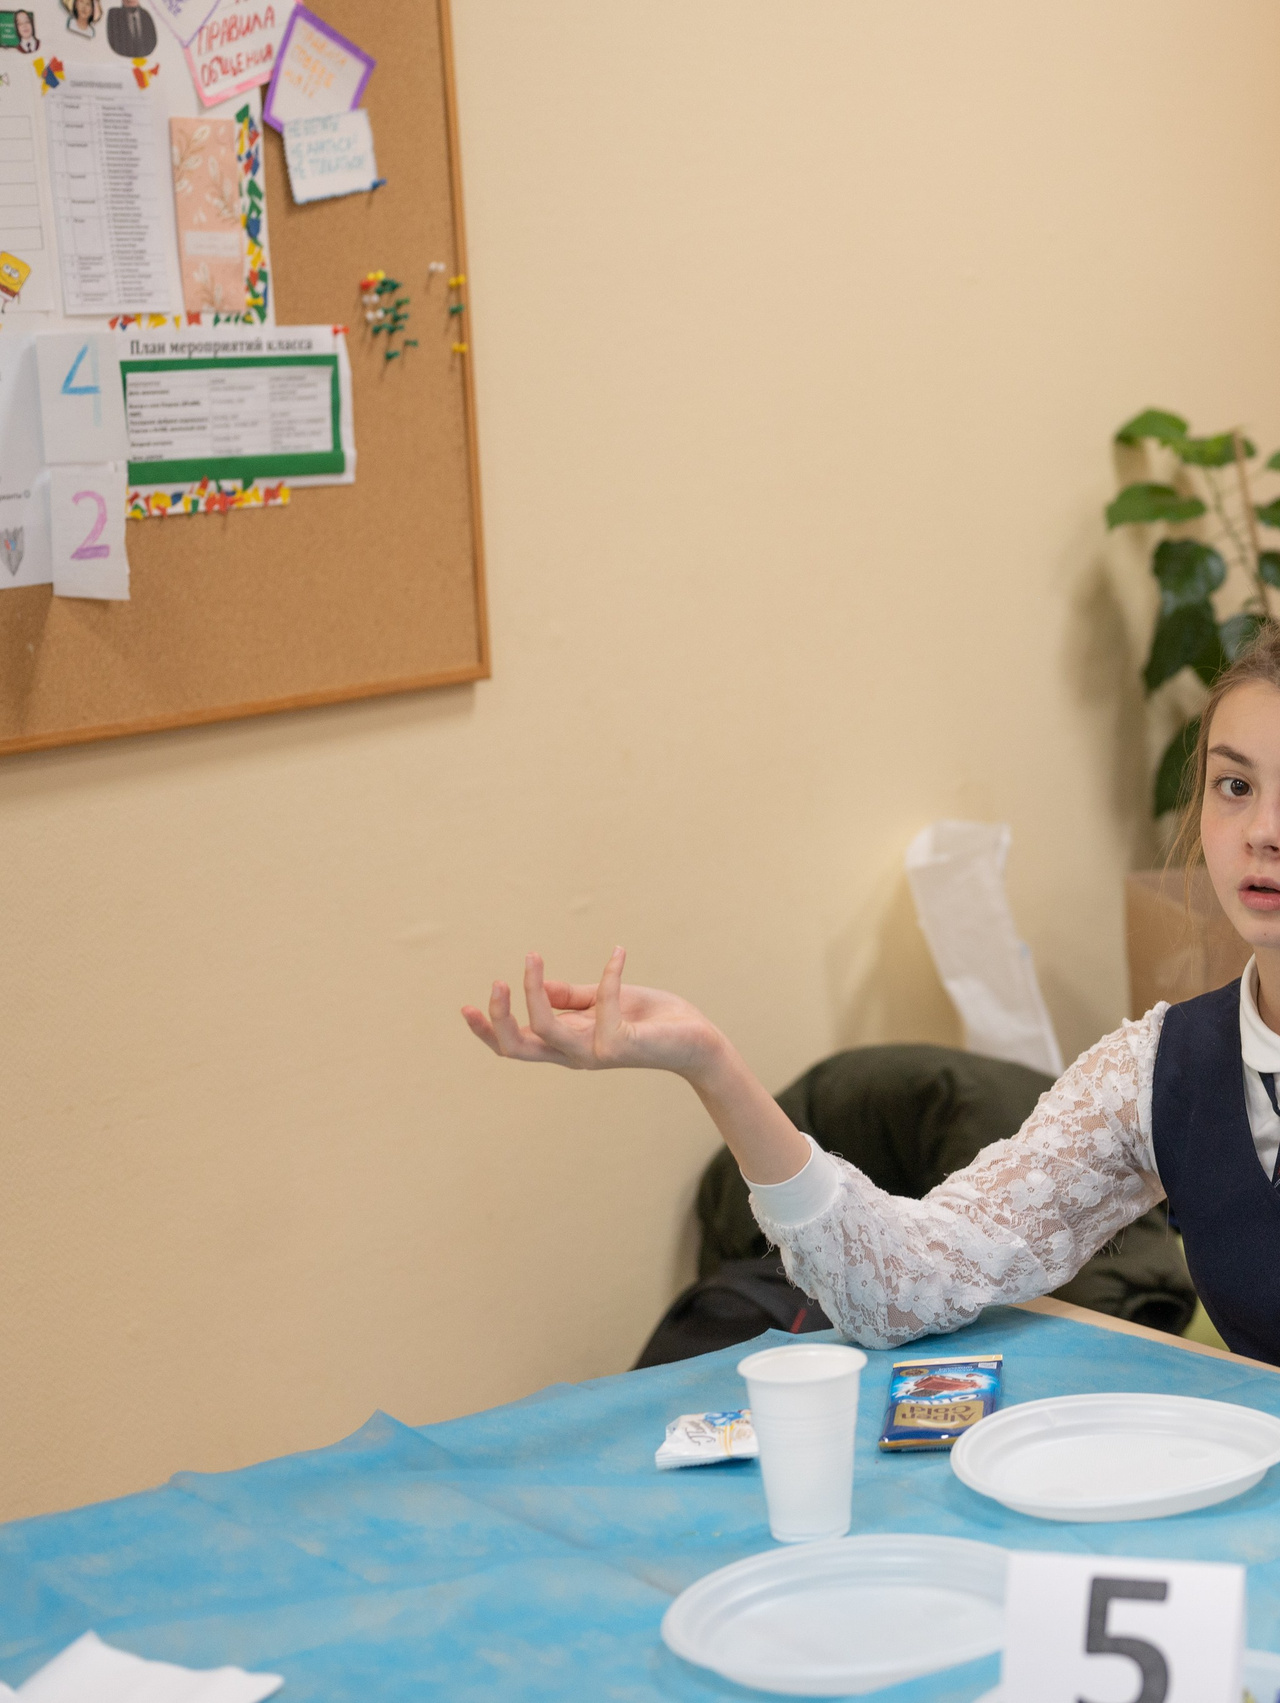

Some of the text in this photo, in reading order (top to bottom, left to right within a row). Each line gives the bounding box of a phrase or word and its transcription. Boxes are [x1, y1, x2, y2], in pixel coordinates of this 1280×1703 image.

[197, 5, 275, 55] ПРАВИЛА
[201, 43, 273, 87] ОБЩЕНИЯ
[130, 337, 313, 359] План мероприятий класса
[70, 490, 111, 560] 2
[901, 1411, 976, 1422] Alpen
[909, 1405, 971, 1416] Gold
[1077, 1577, 1169, 1703] 5
